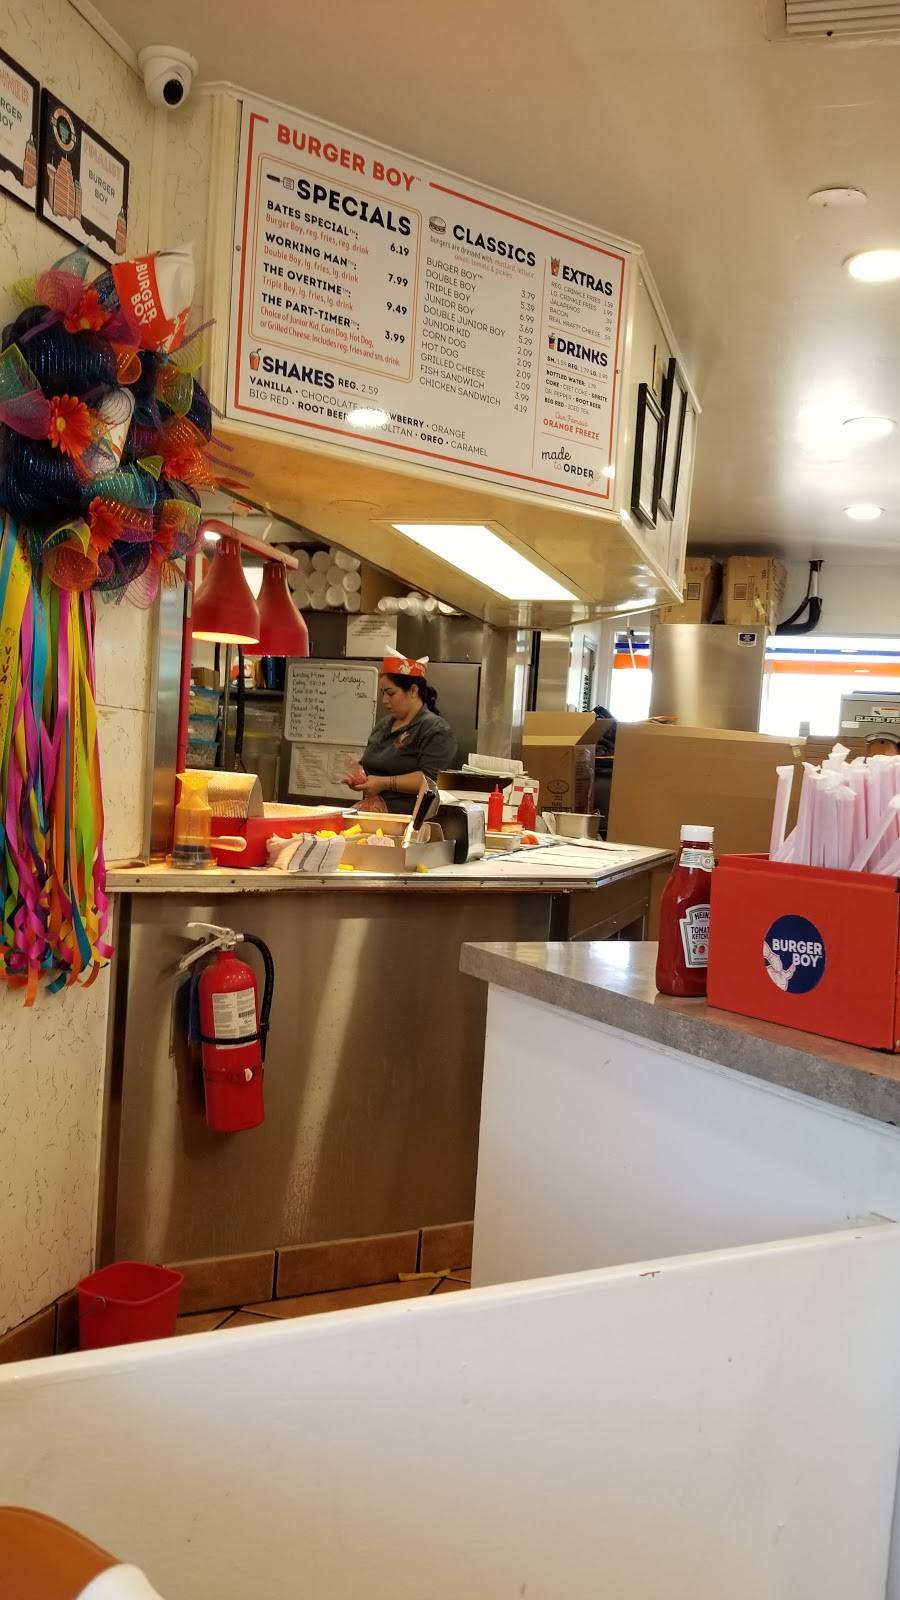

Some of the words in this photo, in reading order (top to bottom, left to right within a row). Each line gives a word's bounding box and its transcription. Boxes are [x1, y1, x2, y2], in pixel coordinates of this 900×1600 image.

[277, 124, 365, 175] BURGER
[88, 170, 115, 198] BURGER
[94, 188, 108, 205] BOY
[297, 178, 411, 236] SPECIALS
[266, 213, 289, 230] Burger
[306, 228, 320, 241] reg.
[352, 242, 369, 255] drink
[268, 200, 301, 219] BATES
[390, 243, 410, 257] 6.19
[453, 224, 536, 267] CLASSICS
[264, 245, 288, 260] Double
[342, 270, 359, 283] drink
[266, 232, 320, 258] WORKING
[388, 274, 409, 287] 7.99
[430, 236, 451, 249] burgers
[452, 244, 460, 252] are
[461, 246, 480, 259] dressed
[482, 255, 493, 264] with
[136, 263, 157, 322] BURGER
[263, 276, 283, 291] Triple
[336, 298, 353, 311] drink
[264, 262, 284, 278] THE
[386, 302, 408, 315] 9.49
[426, 257, 459, 275] BURGER
[521, 290, 536, 301] 3.79
[426, 269, 457, 287] DOUBLE
[460, 281, 476, 292] BOY
[520, 302, 535, 312] 5.39
[562, 265, 613, 296] EXTRAS
[131, 293, 150, 326] BOY
[262, 292, 282, 307] THE
[384, 330, 405, 344] 3.99
[424, 293, 456, 309] JUNIOR
[458, 304, 474, 315] BOY
[519, 324, 533, 334] 3.69
[426, 280, 451, 297] TRIPLE
[454, 290, 471, 302] BOY
[520, 314, 534, 324] 6.99
[550, 307, 569, 319] BACON
[260, 306, 281, 320] Choice
[281, 312, 289, 322] of
[290, 314, 309, 329] Junior
[321, 322, 335, 336] Corn
[350, 332, 361, 344] Hot
[260, 320, 267, 328] or
[268, 322, 288, 336] Grilled
[312, 332, 337, 348] Includes
[350, 344, 364, 356] fries
[364, 348, 374, 358] and
[423, 316, 455, 332] JUNIOR
[457, 328, 471, 338] KID
[517, 347, 532, 357] 2.09
[424, 305, 456, 322] DOUBLE
[458, 316, 488, 332] JUNIOR
[490, 326, 506, 337] BOY
[518, 336, 532, 346] 5.29
[422, 329, 446, 343] CORN
[449, 338, 467, 349] DOG
[517, 358, 532, 369] 2.09
[422, 340, 439, 352] HOT
[440, 346, 459, 359] DOG
[516, 370, 531, 380] 2.09
[557, 338, 608, 367] DRINKS
[262, 356, 335, 390] SHAKES
[338, 377, 359, 391] REG.
[361, 384, 379, 396] 2.59
[420, 364, 439, 376] FISH
[440, 370, 485, 390] SANDWICH
[515, 392, 529, 402] 3.99
[421, 353, 454, 369] GRILLED
[456, 363, 486, 379] CHEESE
[516, 381, 530, 391] 2.09
[546, 370, 568, 381] BOTTLED
[546, 379, 560, 388] COKE
[592, 394, 608, 403] SPRITE
[250, 376, 292, 395] VANILLA
[432, 423, 466, 440] ORANGE
[420, 377, 456, 393] CHICKEN
[458, 388, 501, 406] SANDWICH
[545, 397, 554, 405] BIG
[555, 400, 565, 408] RED
[250, 388, 267, 401] BIG
[270, 394, 289, 406] RED
[298, 402, 324, 416] ROOT
[420, 433, 444, 445] OREO
[451, 441, 488, 457] CARAMEL
[543, 418, 574, 433] ORANGE
[576, 428, 600, 440] FREEZE
[542, 446, 572, 461] made
[564, 464, 594, 479] ORDER
[694, 912, 711, 920] HEIN
[772, 939, 823, 955] BURGER
